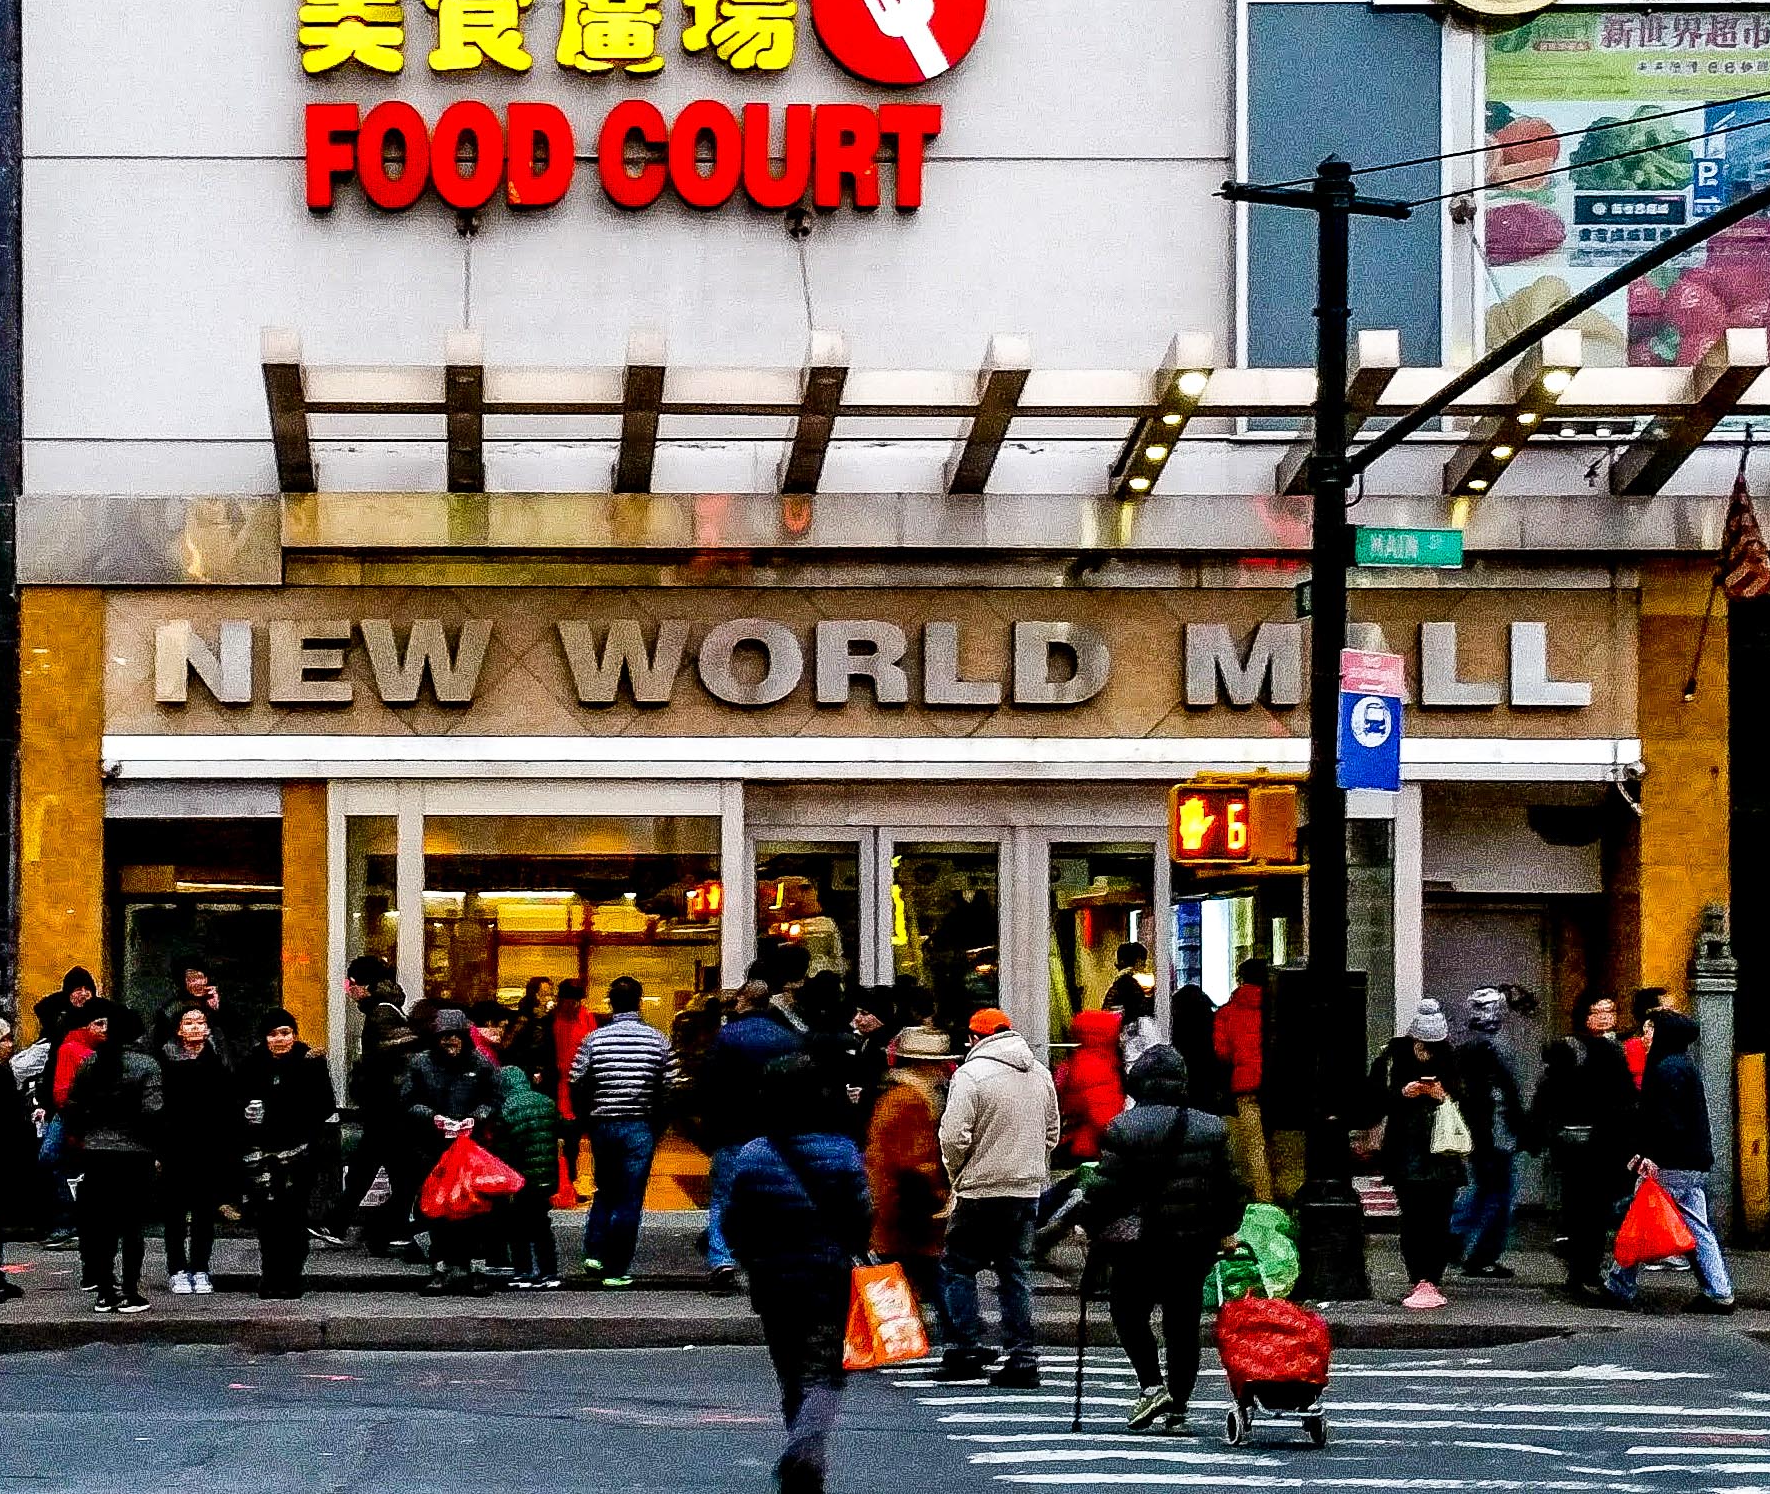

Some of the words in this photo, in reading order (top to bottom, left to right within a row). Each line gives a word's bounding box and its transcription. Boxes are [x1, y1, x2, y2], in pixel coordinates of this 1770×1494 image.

[305, 100, 575, 210] FOOD
[599, 100, 942, 210] COURT
[152, 618, 494, 707] NEW
[557, 618, 1112, 707] WORLD
[1184, 618, 1594, 709] MLL
